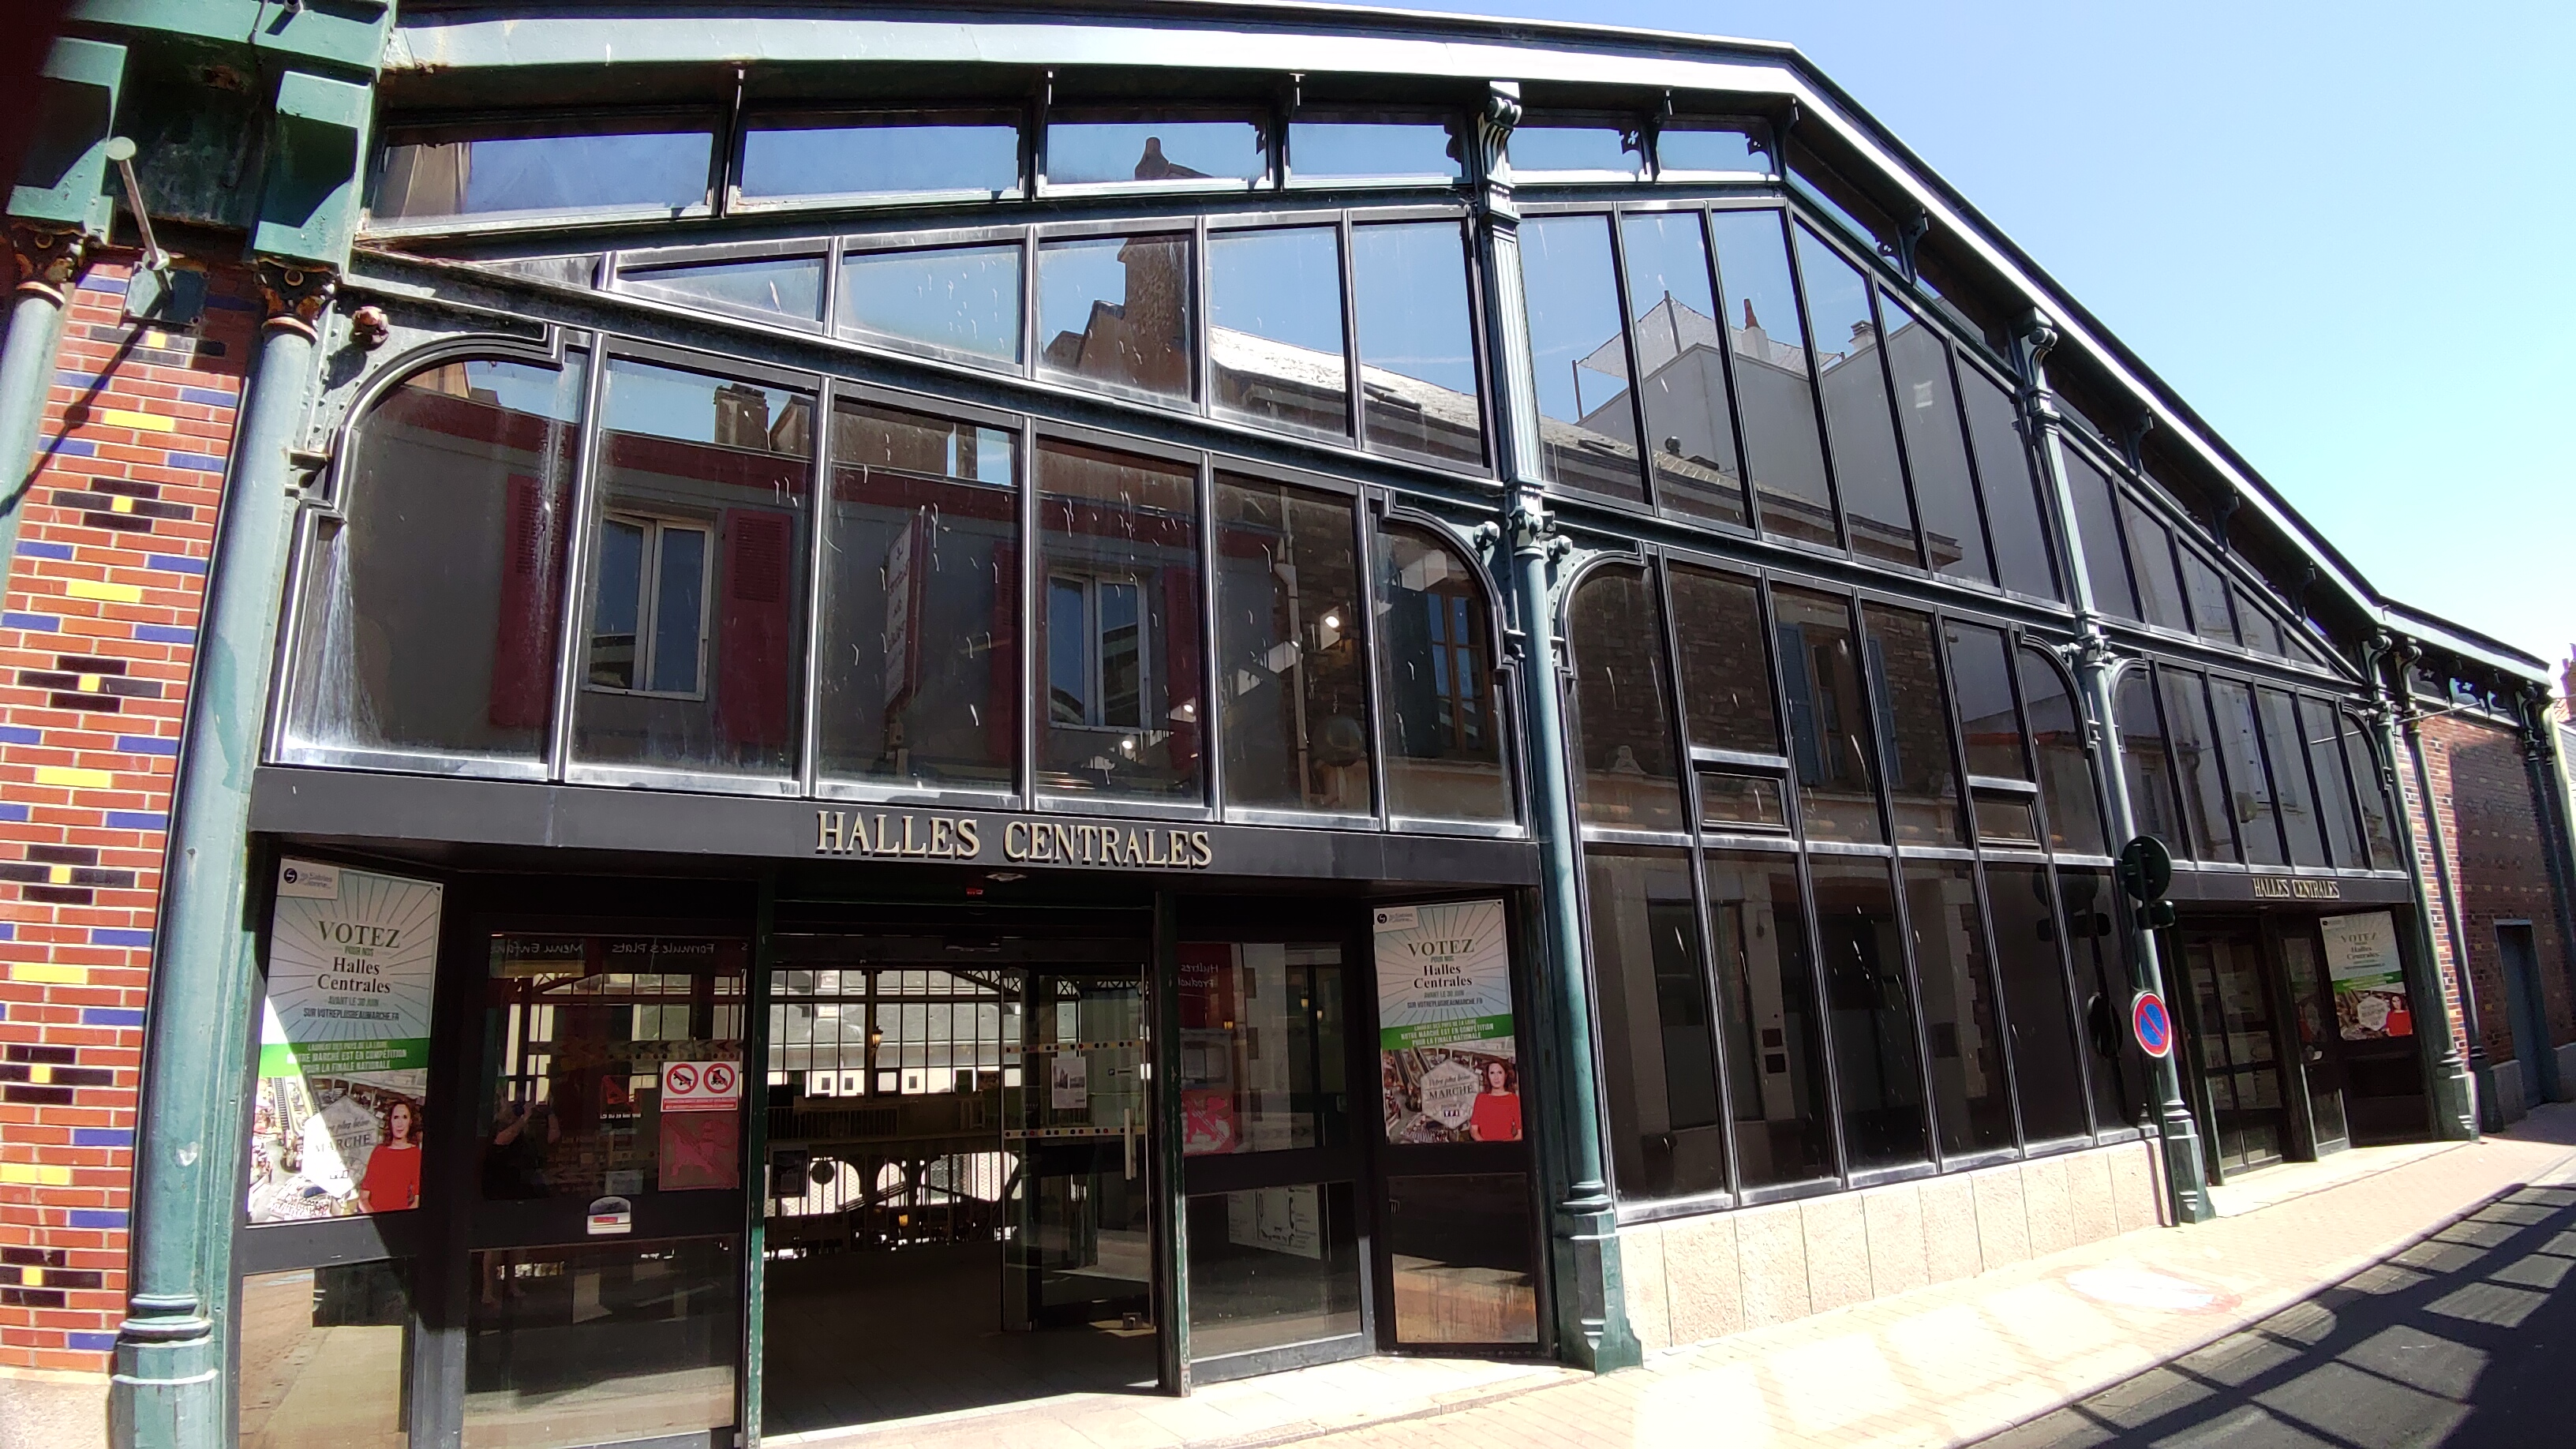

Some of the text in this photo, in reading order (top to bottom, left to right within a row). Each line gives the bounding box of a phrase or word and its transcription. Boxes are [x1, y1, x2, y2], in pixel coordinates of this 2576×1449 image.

[815, 810, 1213, 868] HALLES CENTRALES
[2252, 877, 2340, 899] HALLES CENTRALES
[318, 920, 401, 949] VOTEZ
[1407, 938, 1475, 957] VOTEZ
[332, 956, 380, 975] Halles
[1424, 964, 1461, 975] Halles
[317, 973, 391, 994] Centrales
[1413, 975, 1473, 989] Centrales
